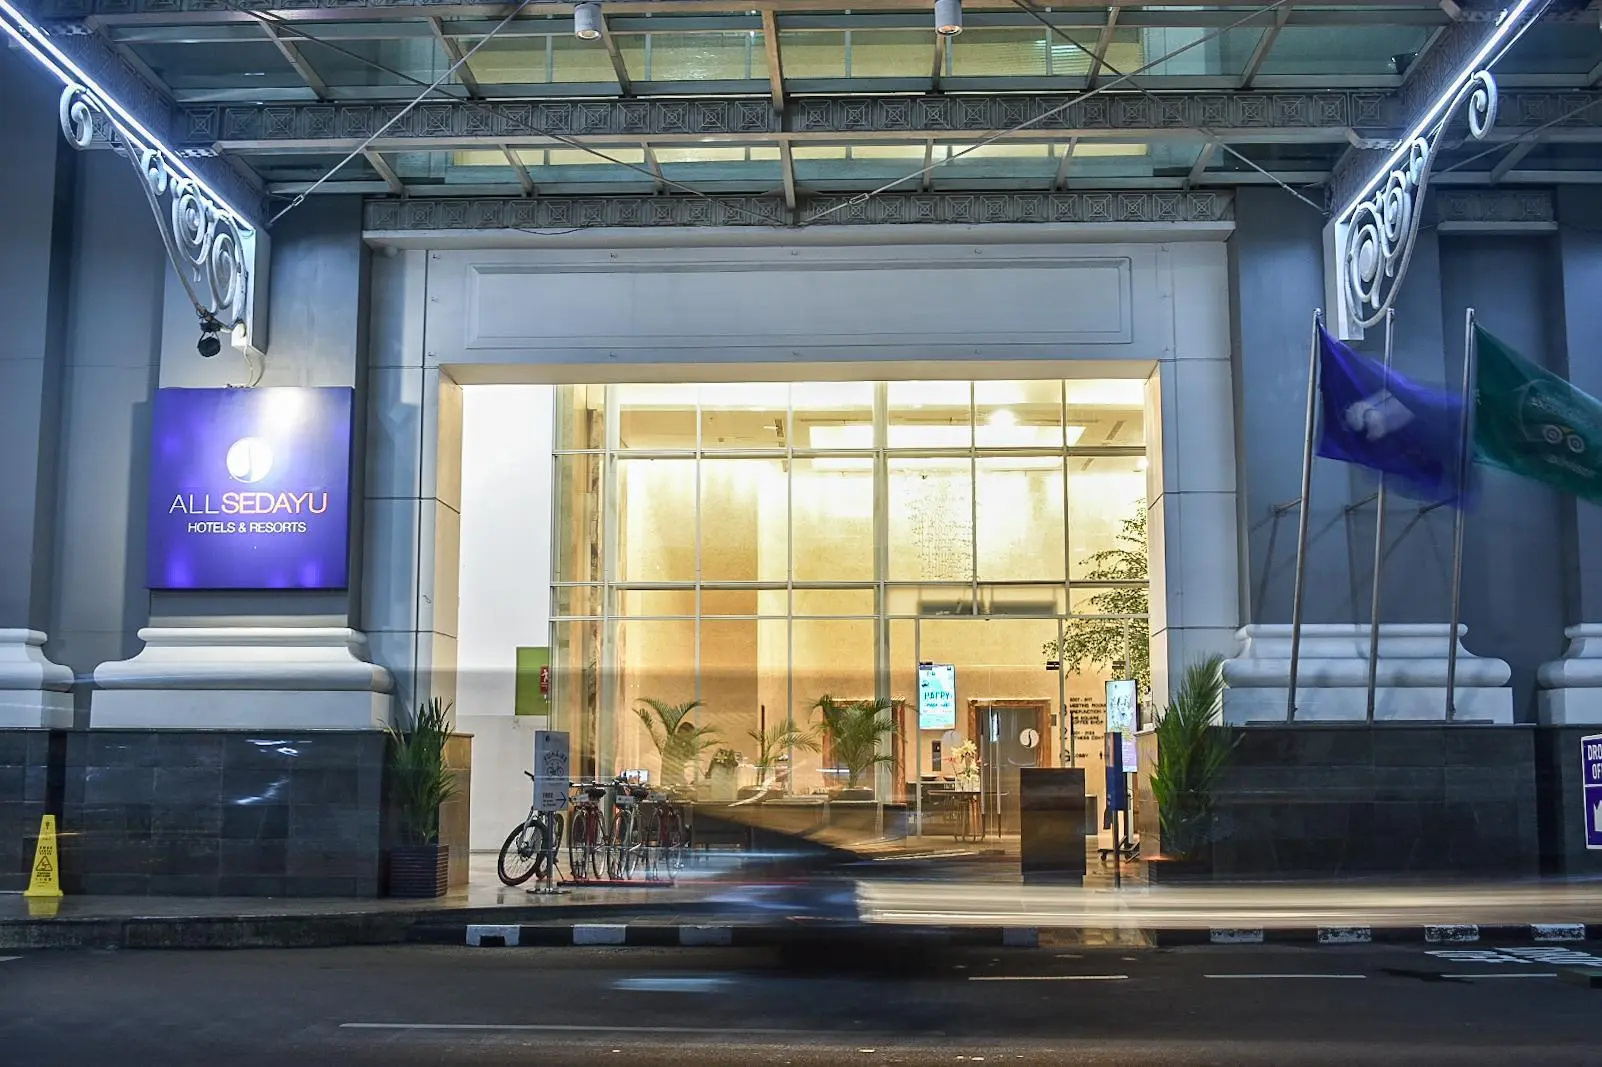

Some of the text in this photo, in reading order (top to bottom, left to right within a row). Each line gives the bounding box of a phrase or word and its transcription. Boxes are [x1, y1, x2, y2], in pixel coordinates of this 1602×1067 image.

[188, 521, 307, 533] HOTELS & RESORTS
[1592, 763, 1602, 780] OF
